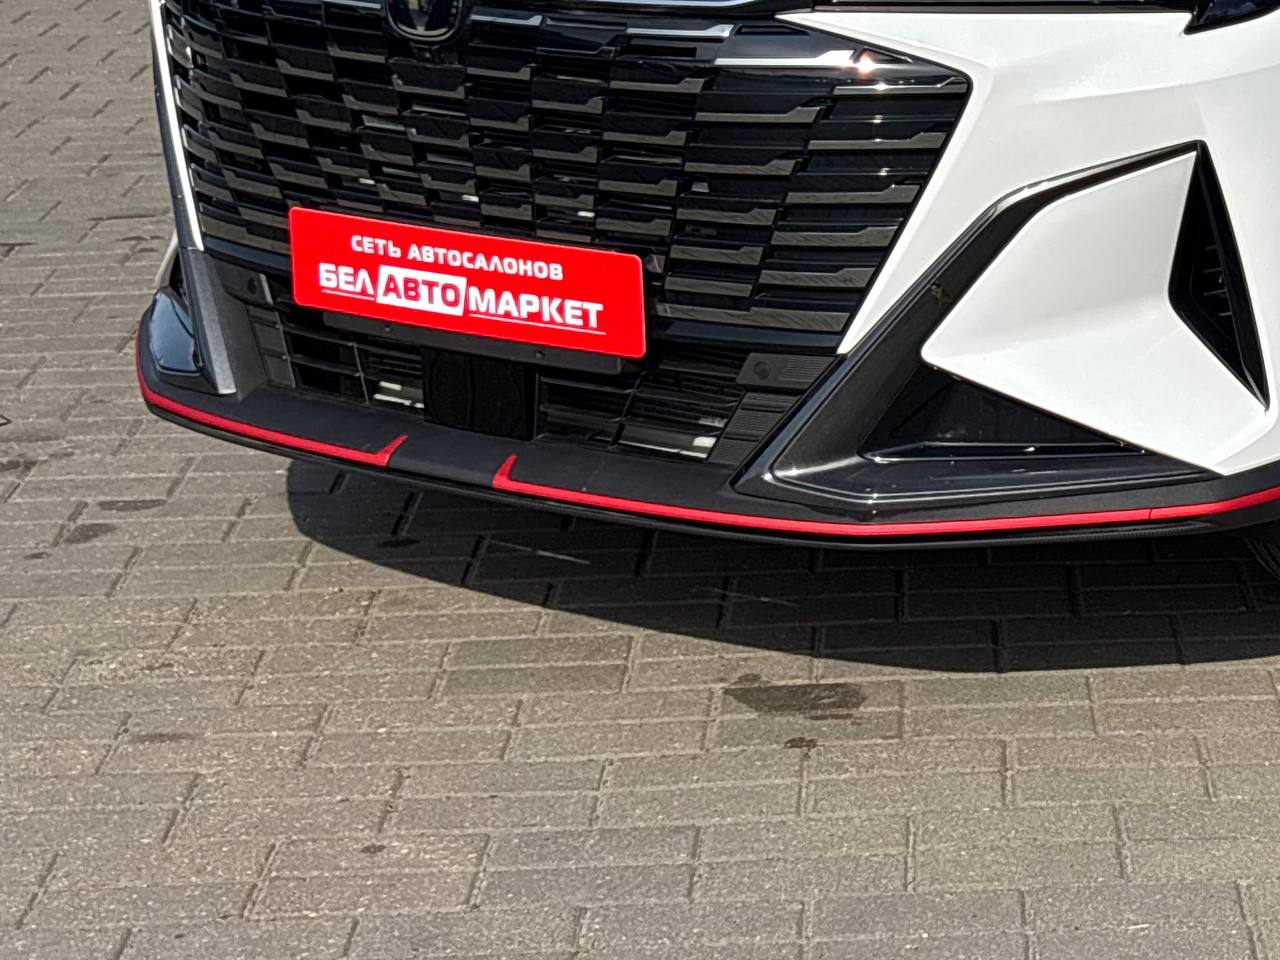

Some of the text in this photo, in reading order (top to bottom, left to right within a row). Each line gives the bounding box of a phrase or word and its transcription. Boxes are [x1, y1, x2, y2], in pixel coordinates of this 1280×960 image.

[350, 234, 564, 281] СЕТЬ АВТОСАЛОНОВ
[318, 262, 604, 330] БЕЛАВТОМАРКЕТ
